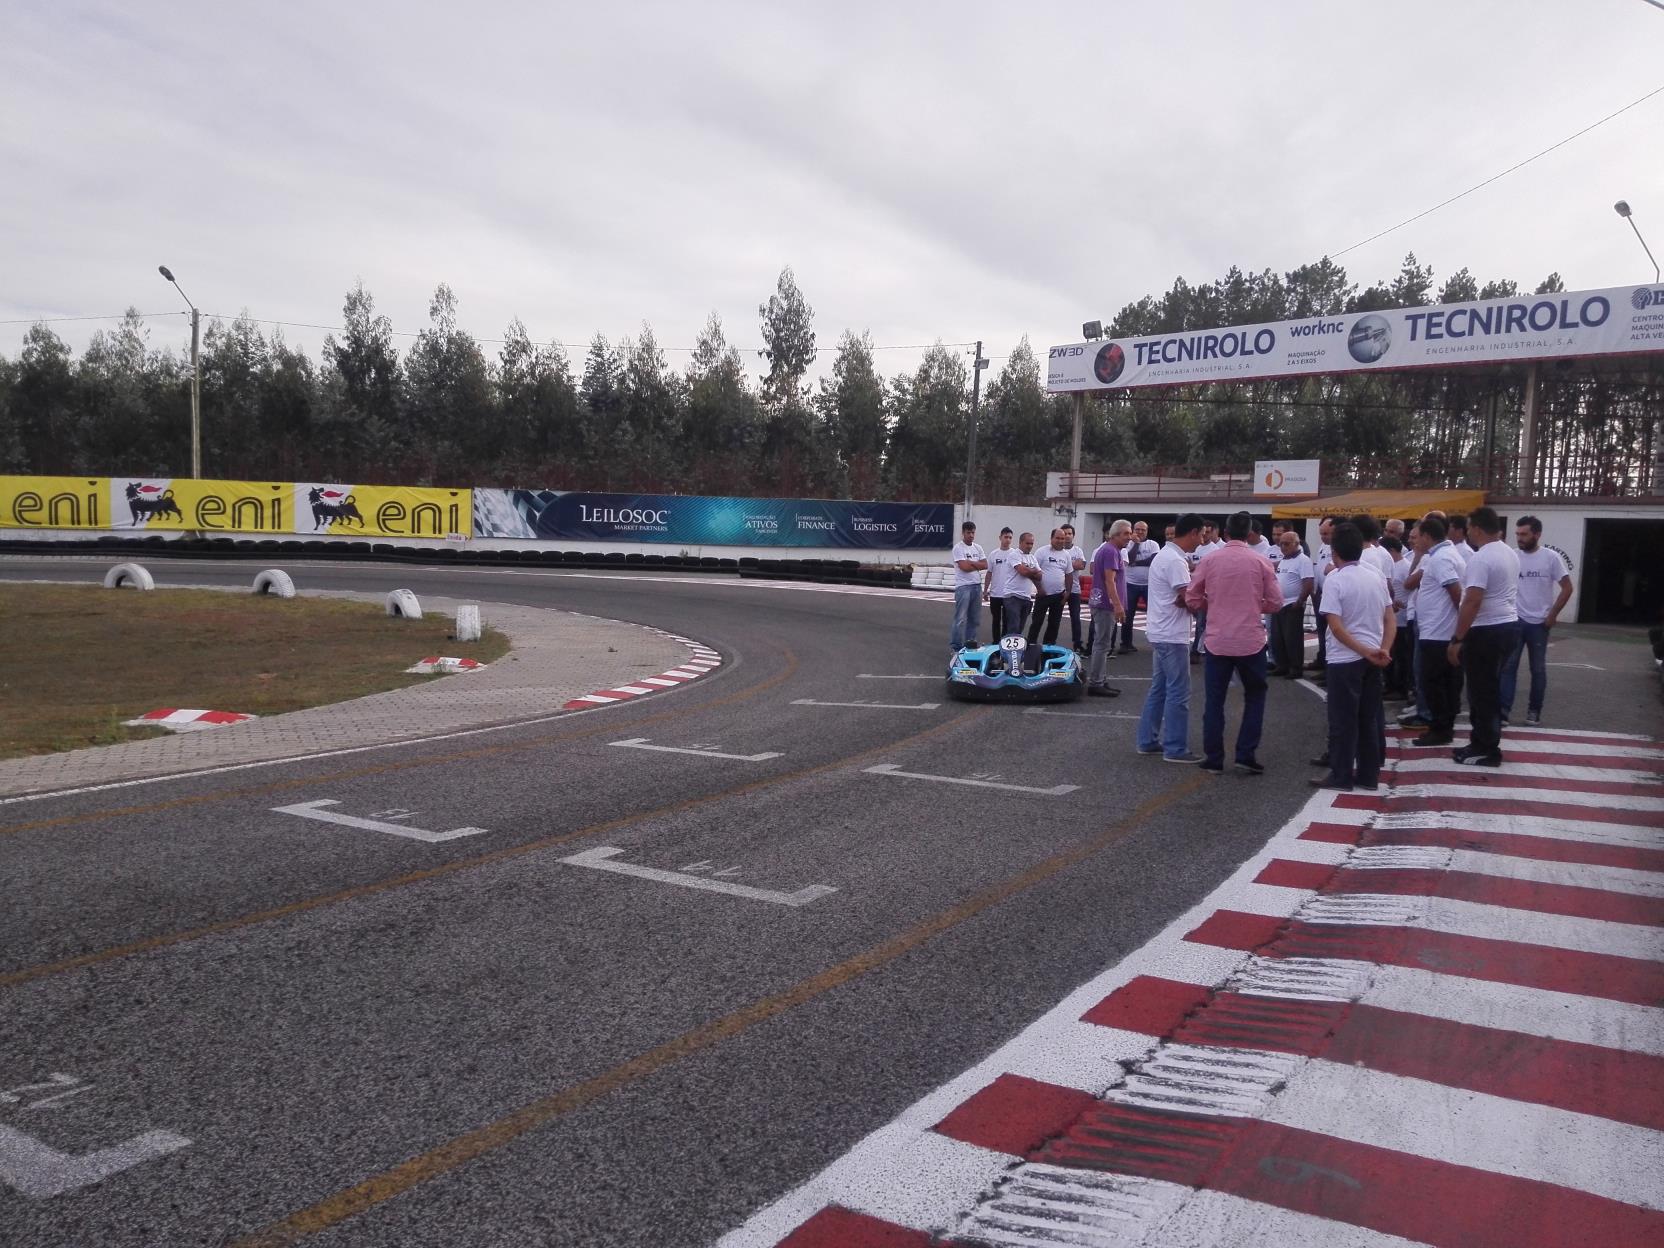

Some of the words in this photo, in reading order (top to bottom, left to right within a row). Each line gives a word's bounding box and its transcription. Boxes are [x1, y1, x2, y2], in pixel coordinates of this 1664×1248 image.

[1404, 295, 1611, 342] TECNIROLO
[1632, 314, 1664, 323] CENTRO
[1630, 332, 1650, 341] ALTA
[1049, 346, 1084, 359] ZW3D
[1133, 328, 1276, 366] TECNIROLO
[1426, 345, 1485, 355] ENGENHARIA
[1148, 367, 1190, 378] ENGENHARIA
[12, 480, 98, 527] eni
[195, 485, 281, 530] eni
[376, 491, 459, 534] eni
[579, 504, 668, 525] LEILOSOC
[639, 524, 668, 532] PARTNERS
[745, 520, 778, 529] ATIVOS
[797, 521, 836, 530] FINANCE
[853, 522, 897, 532] LOGISTICS
[914, 524, 945, 533] ESTATE
[1544, 543, 1574, 572] KARTING
[1005, 638, 1019, 649] 25
